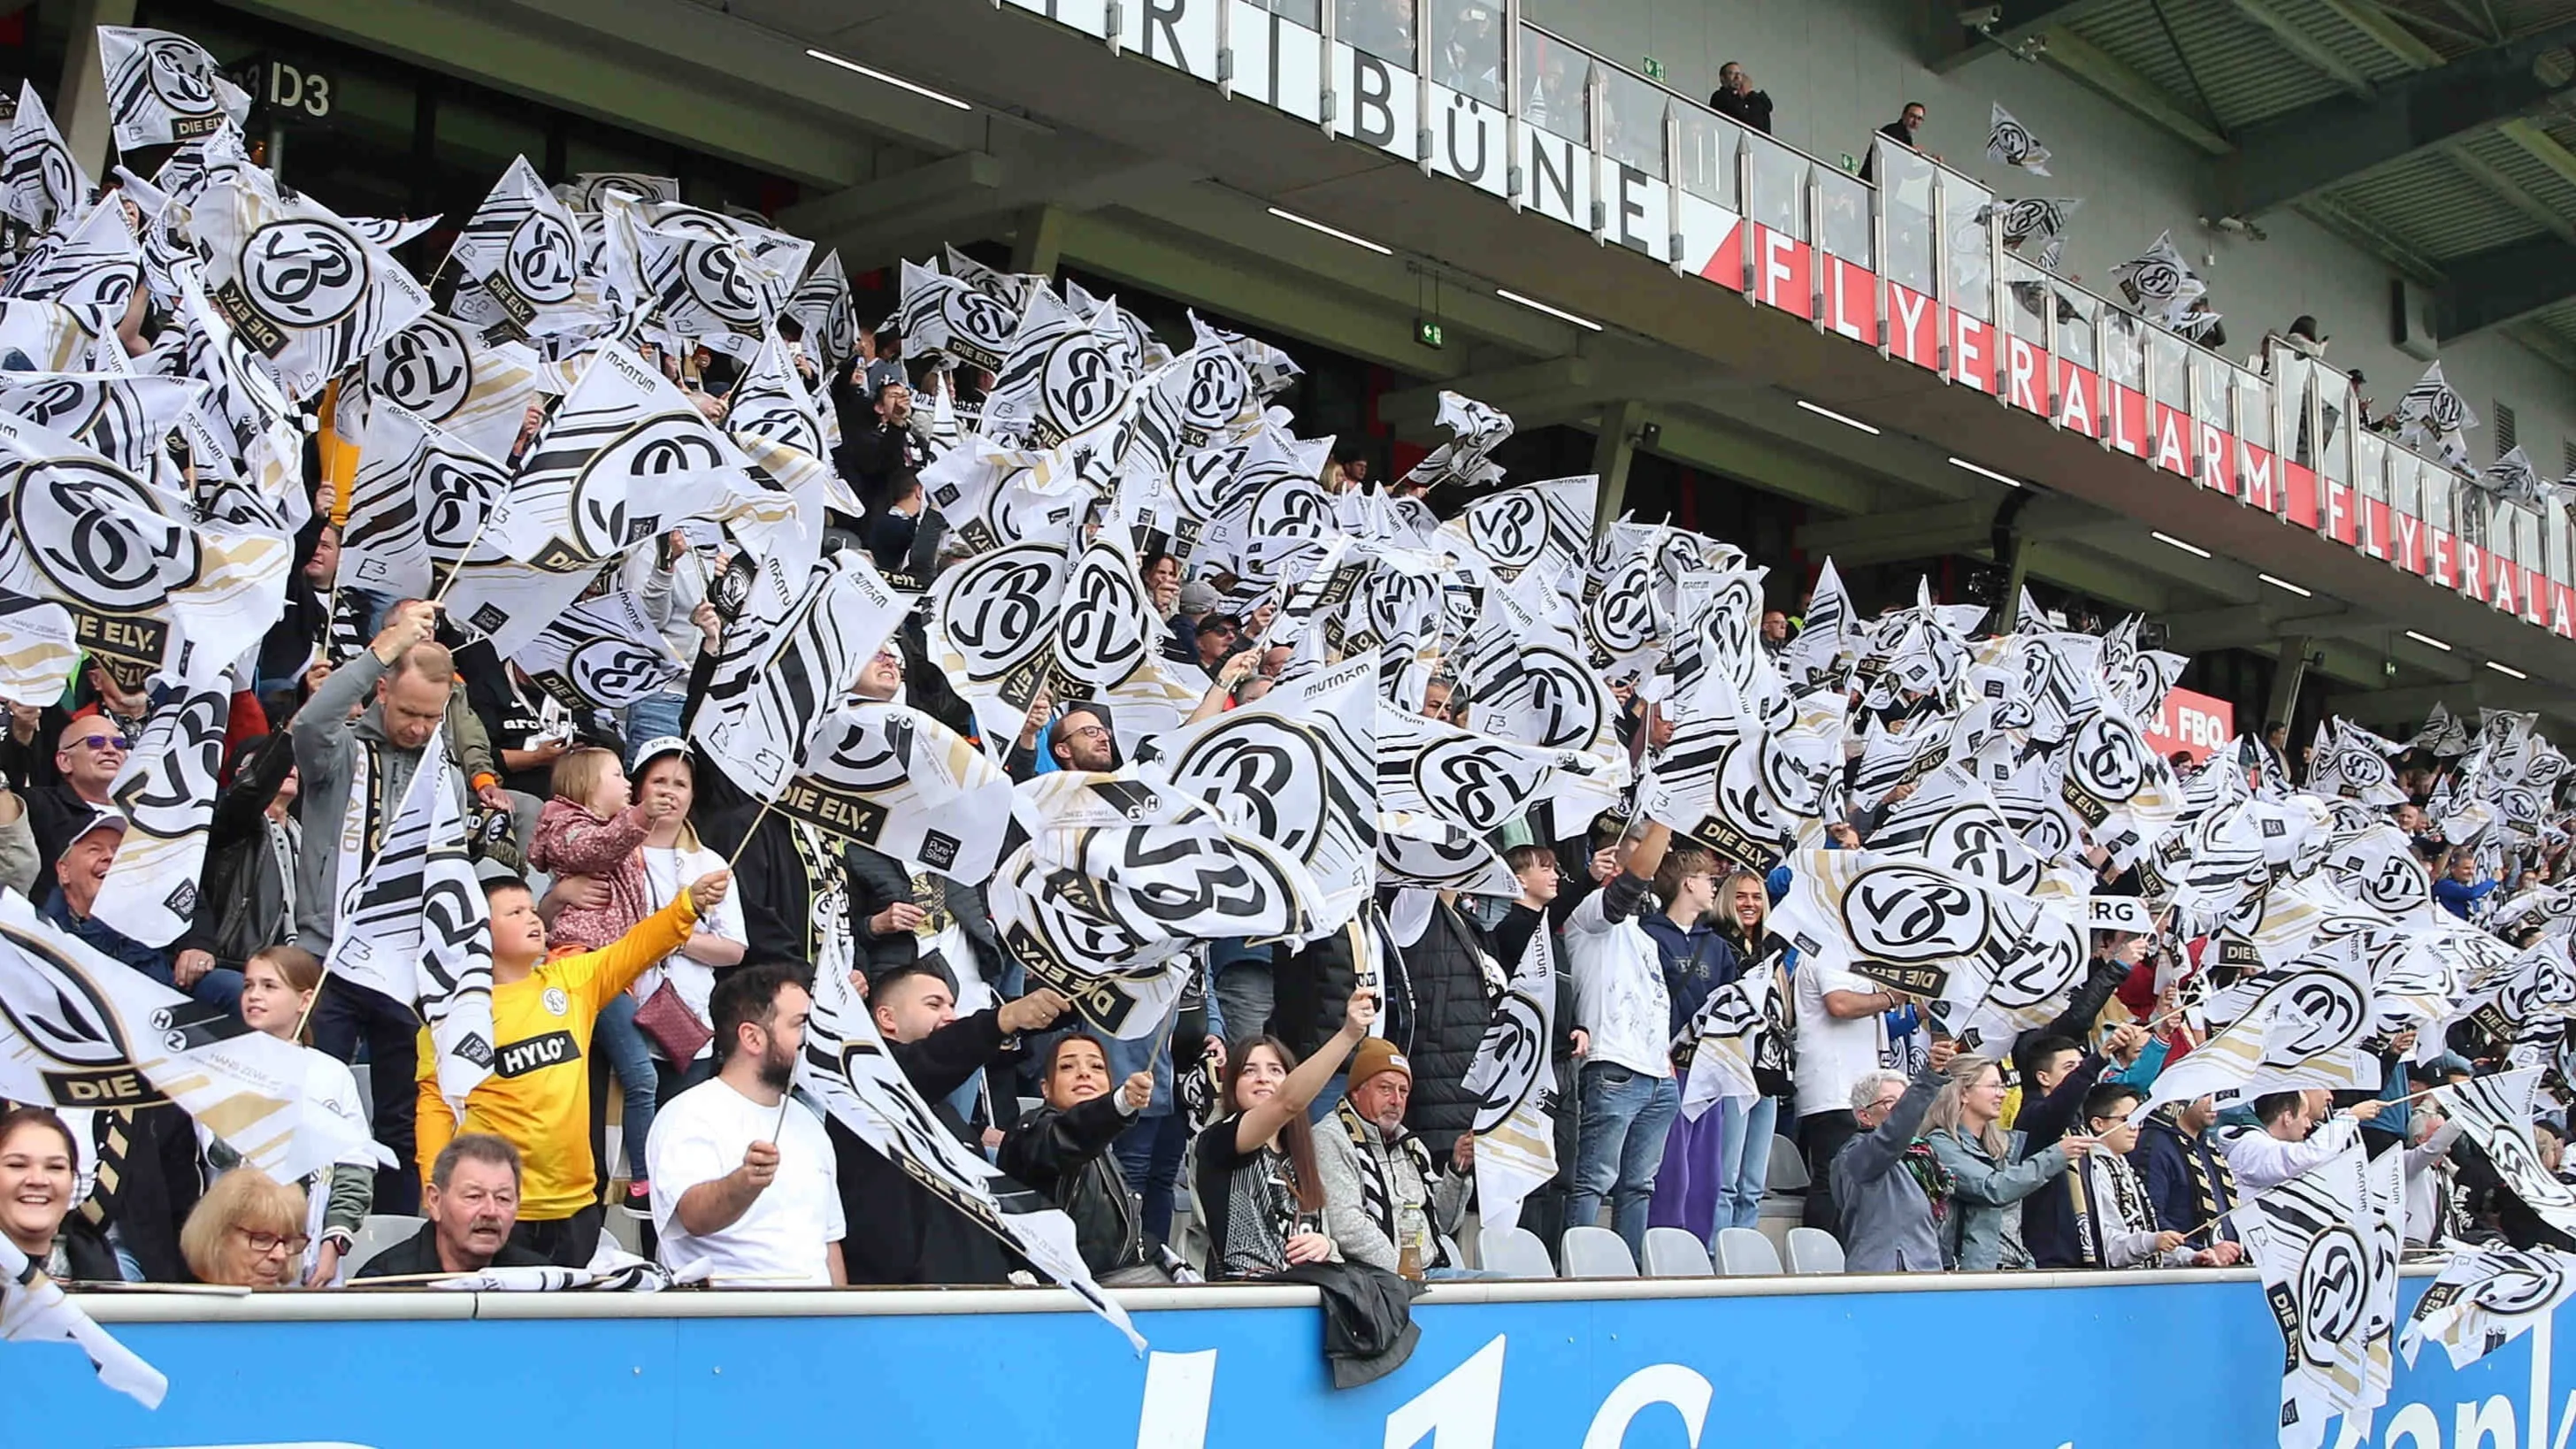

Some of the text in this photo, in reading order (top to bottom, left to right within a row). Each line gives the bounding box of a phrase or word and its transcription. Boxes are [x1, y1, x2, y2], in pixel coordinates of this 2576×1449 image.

[270, 61, 330, 118] D3
[178, 120, 203, 134] DIE
[1046, 0, 1648, 256] RIBÜNE
[489, 277, 510, 298] DIE
[953, 341, 974, 358] DIE
[1766, 228, 2572, 639] FLYERALARM FLYERALA
[74, 613, 97, 637] IE
[1703, 822, 1738, 847] DIE
[503, 1039, 561, 1074] HYLO
[66, 1074, 142, 1100] DIE
[2273, 1292, 2298, 1328] DIE
